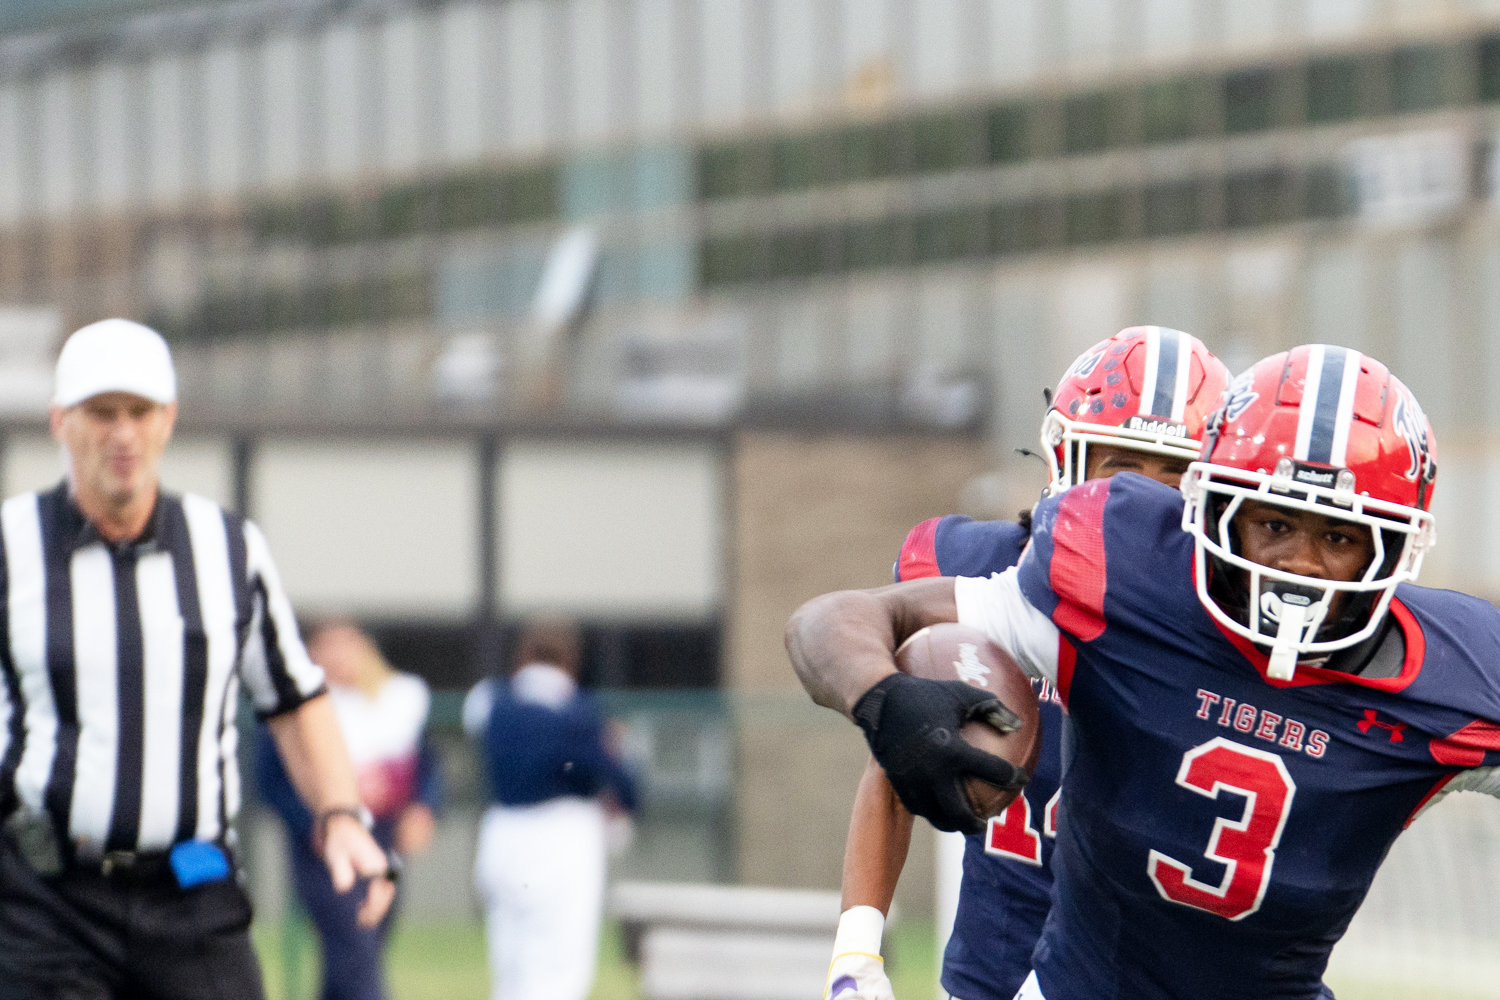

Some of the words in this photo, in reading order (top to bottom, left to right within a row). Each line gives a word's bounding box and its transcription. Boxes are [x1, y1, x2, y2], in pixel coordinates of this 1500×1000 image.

[1129, 416, 1187, 438] Riddell
[1196, 688, 1330, 758] TIGERS
[1147, 736, 1297, 921] 3
